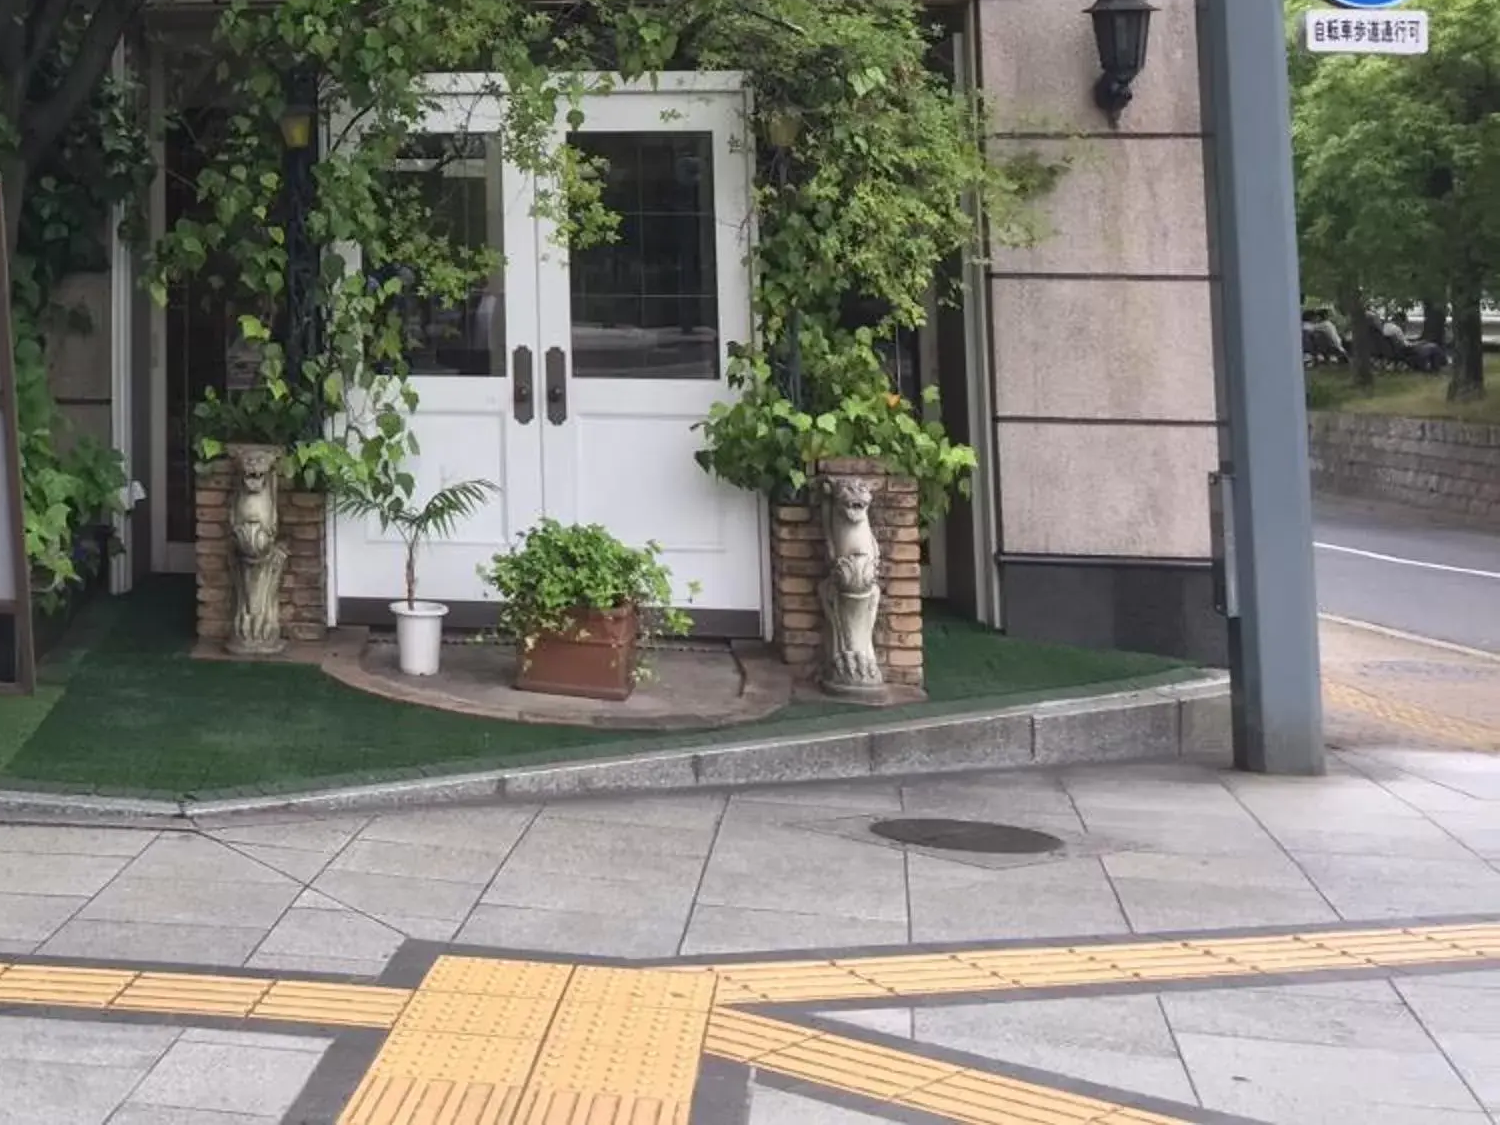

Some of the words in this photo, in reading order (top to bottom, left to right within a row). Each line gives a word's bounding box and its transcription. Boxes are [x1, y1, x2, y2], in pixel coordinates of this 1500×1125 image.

[1314, 19, 1421, 44] 自転車歩道通行可
